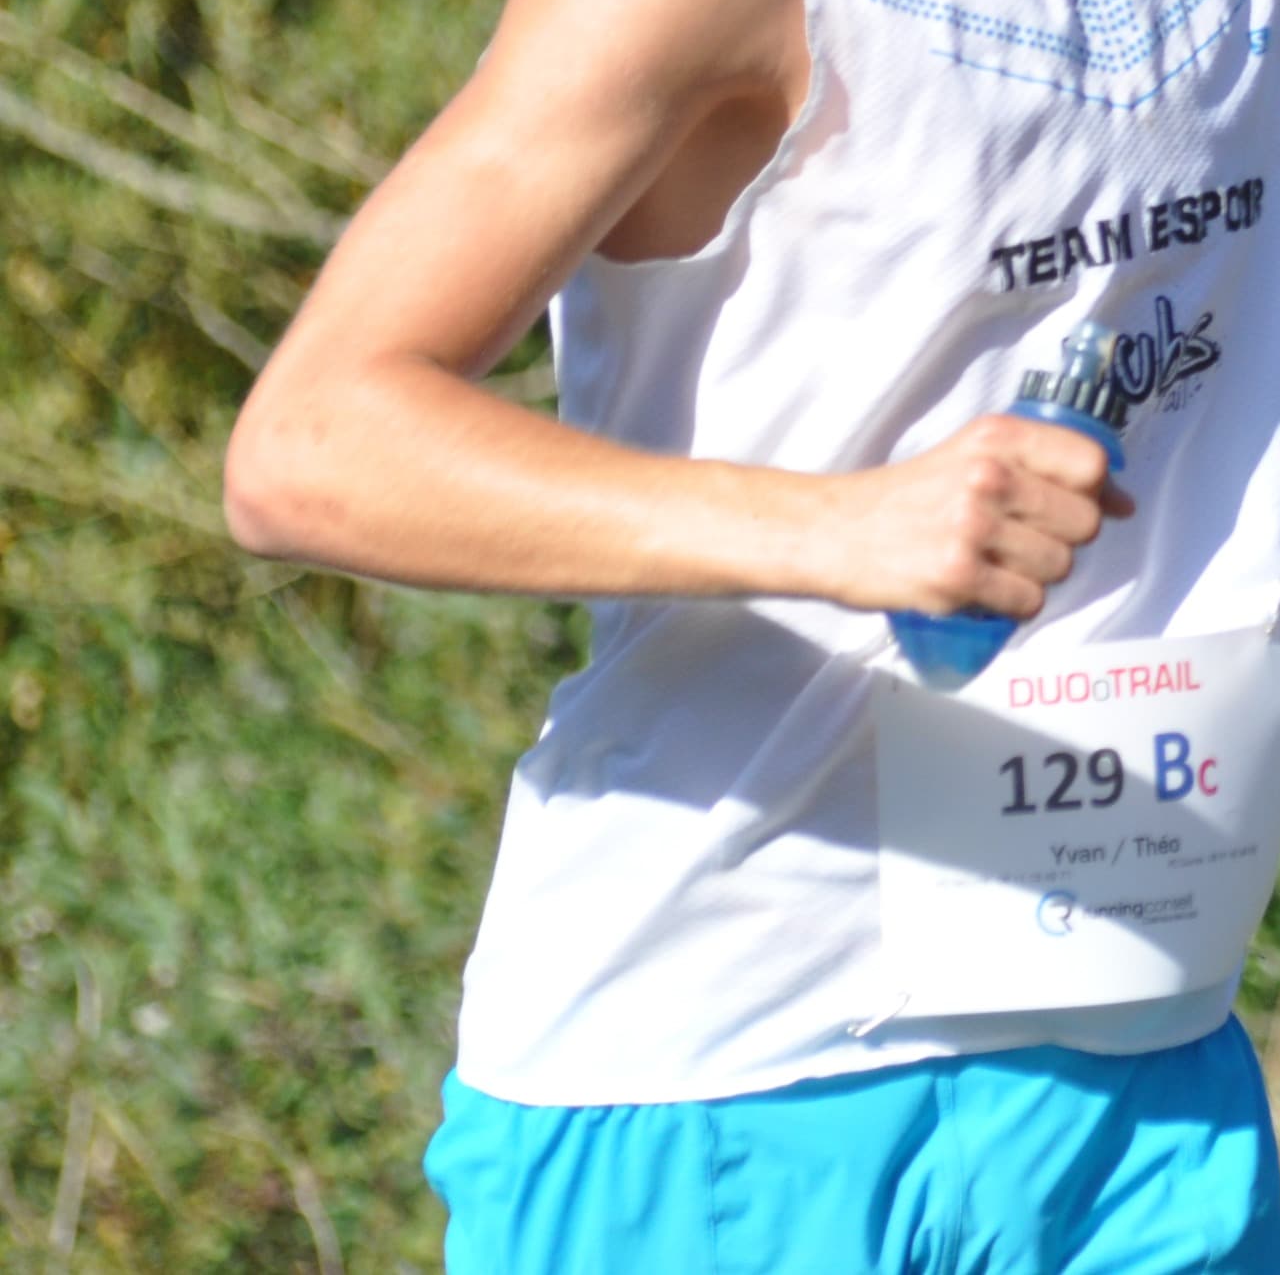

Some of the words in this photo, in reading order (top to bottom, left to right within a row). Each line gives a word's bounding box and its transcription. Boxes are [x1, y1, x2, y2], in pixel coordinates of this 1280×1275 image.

[990, 213, 1135, 292] TEAM
[1000, 748, 1125, 815] 129
[1051, 845, 1105, 864] Yvan
[1133, 835, 1181, 858] Théo
